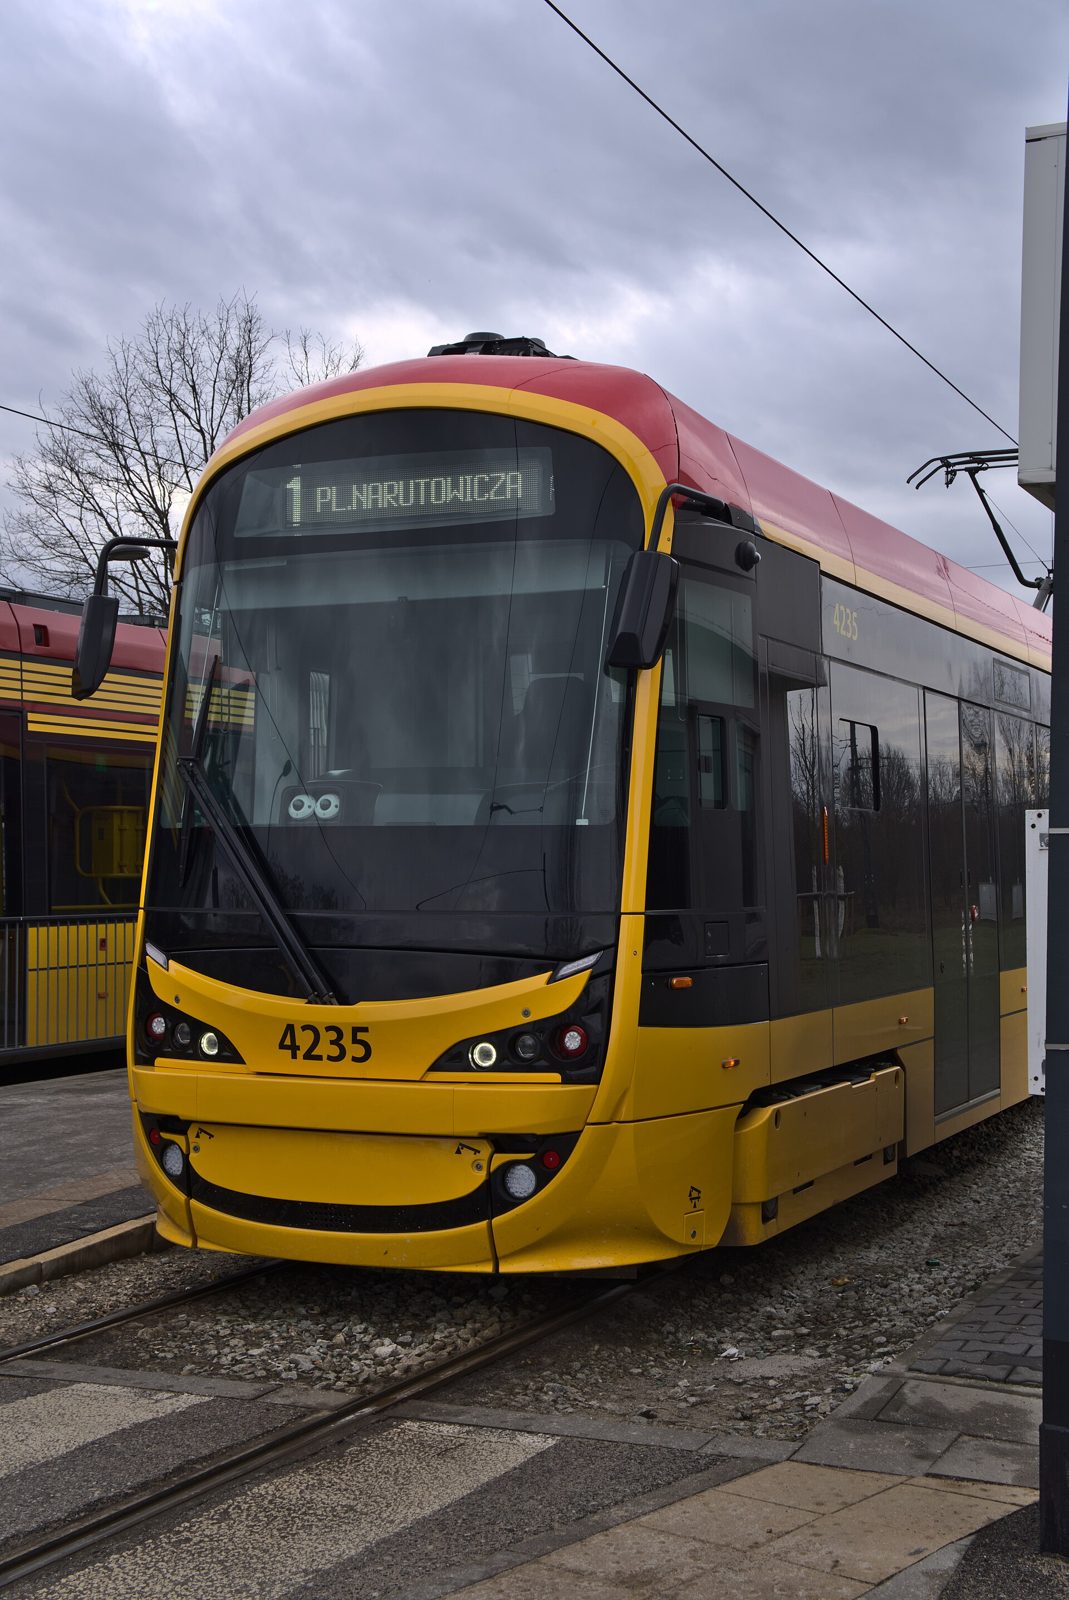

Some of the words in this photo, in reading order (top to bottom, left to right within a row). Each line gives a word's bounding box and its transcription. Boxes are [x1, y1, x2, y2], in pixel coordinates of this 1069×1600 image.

[286, 476, 301, 525] 1
[316, 471, 522, 513] PL.NARUTOWICZA
[833, 602, 858, 641] 4235
[278, 1023, 372, 1064] 4235
